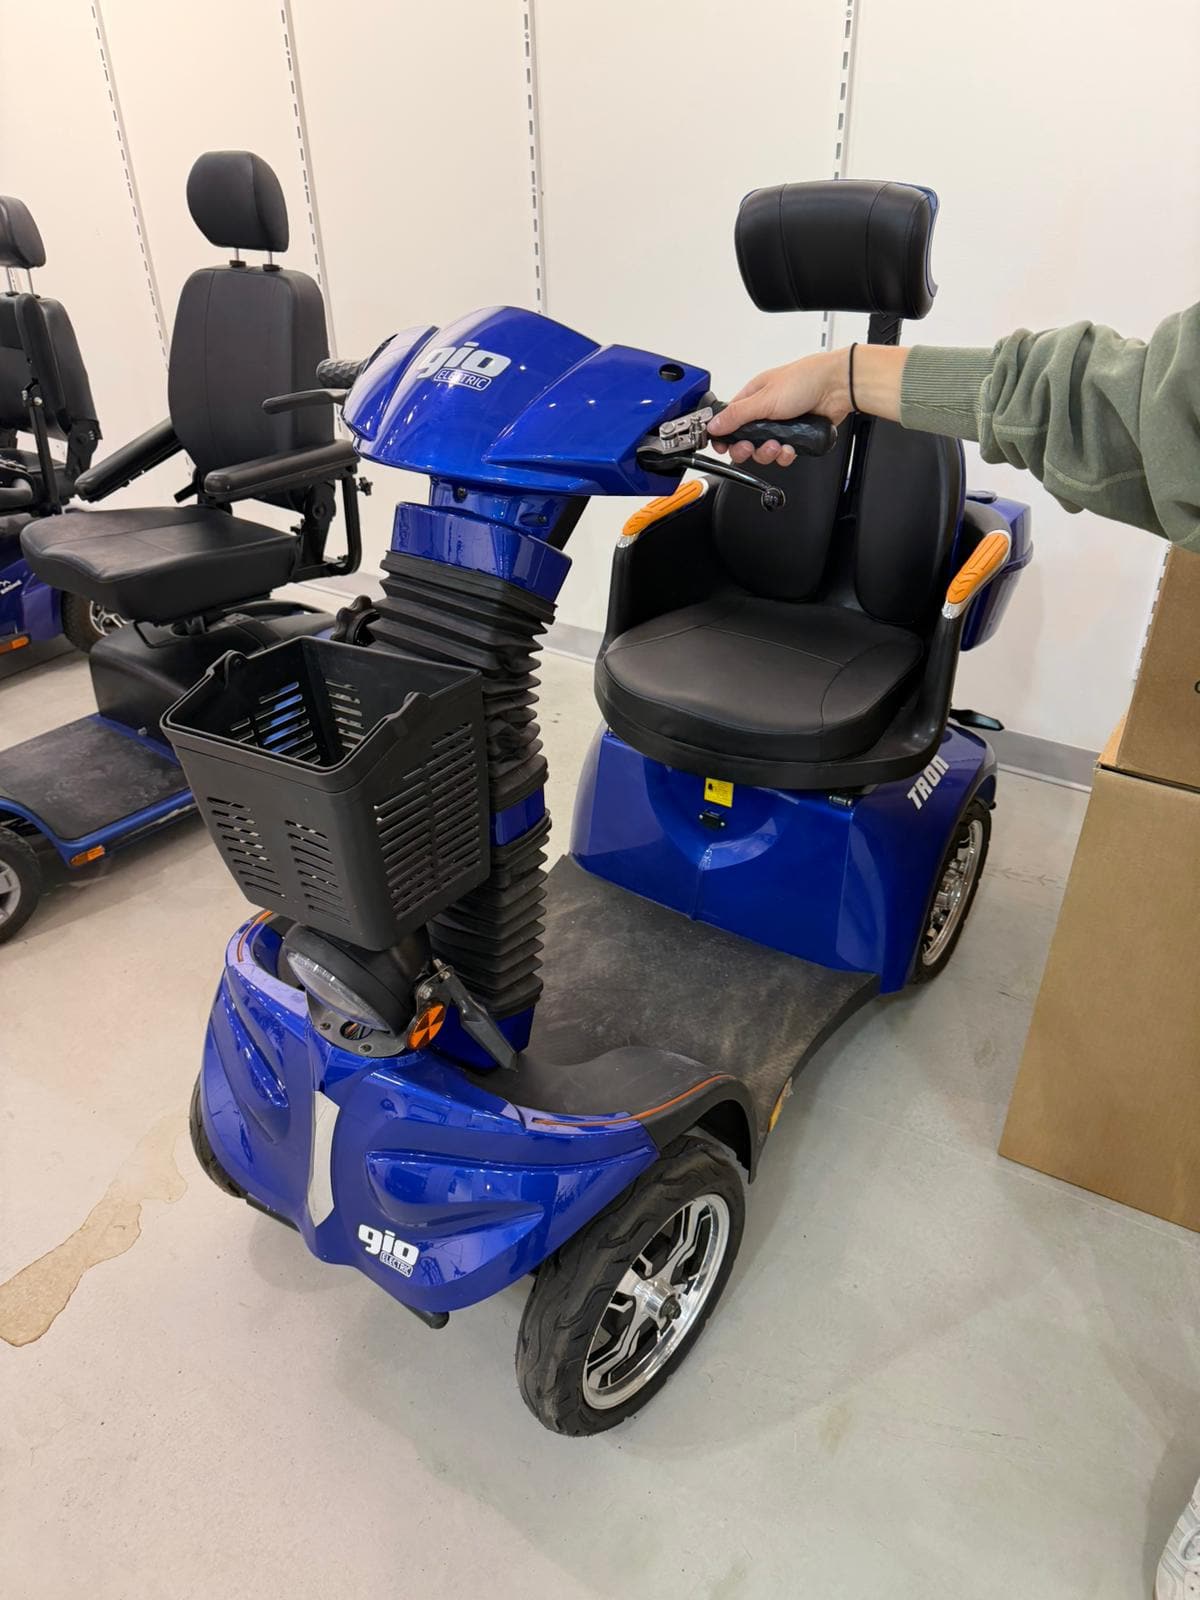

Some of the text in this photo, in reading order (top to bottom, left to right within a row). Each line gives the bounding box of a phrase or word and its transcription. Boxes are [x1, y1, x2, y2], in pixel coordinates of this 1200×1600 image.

[416, 341, 511, 378] gio
[907, 754, 950, 810] TRON
[358, 1223, 420, 1266] gio
